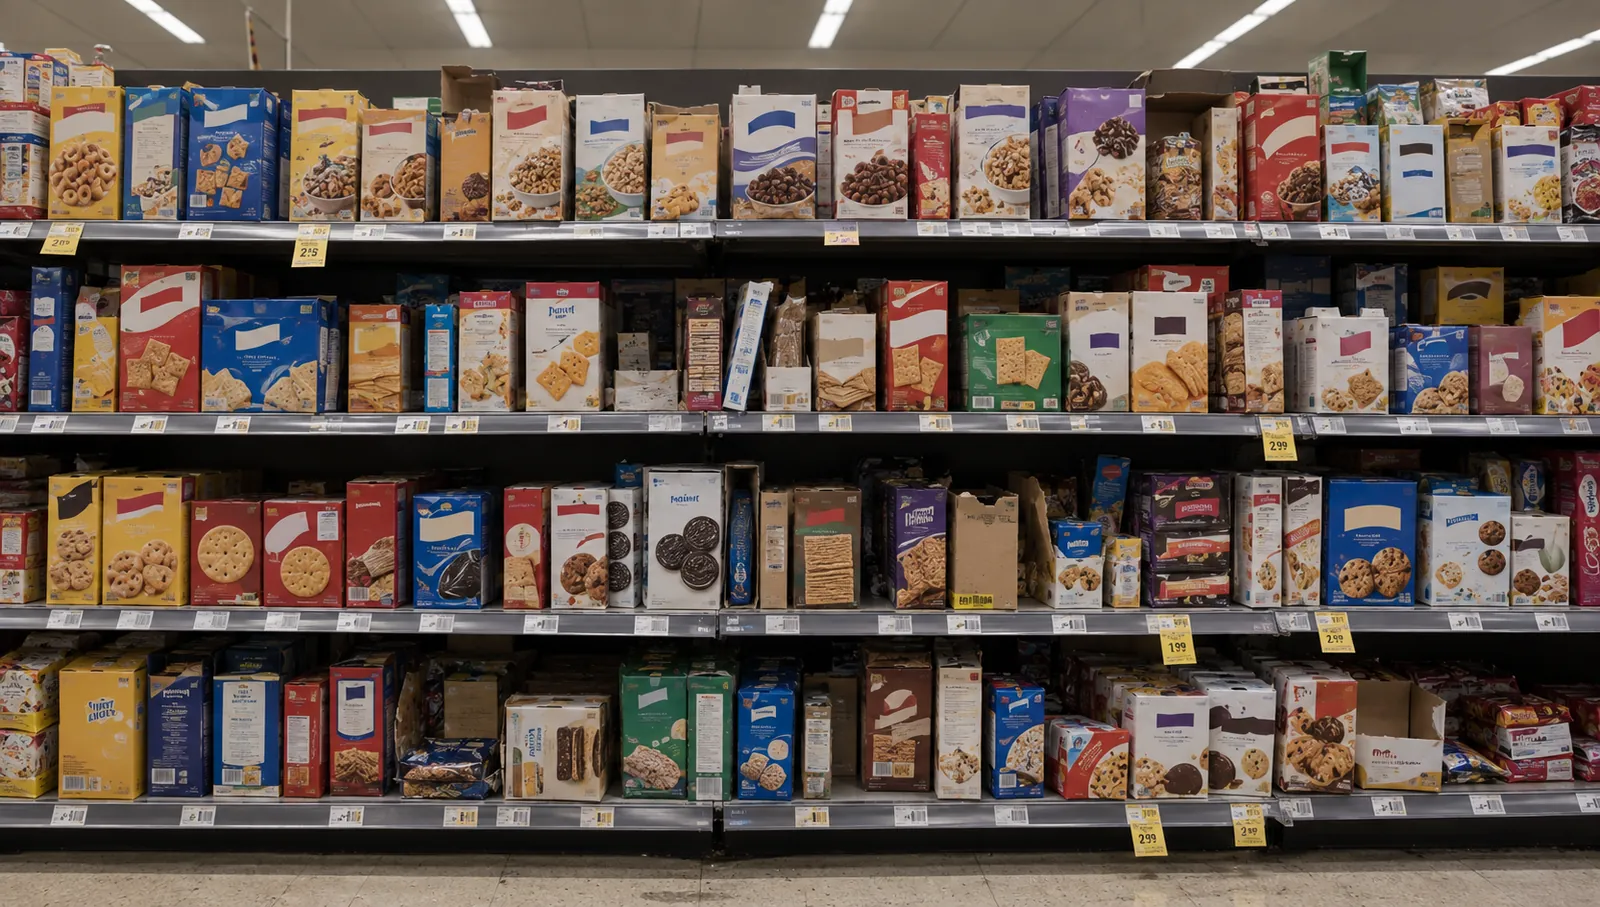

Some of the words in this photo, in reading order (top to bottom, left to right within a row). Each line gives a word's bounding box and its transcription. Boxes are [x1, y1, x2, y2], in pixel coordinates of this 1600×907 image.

[1269, 440, 1288, 451] 299
[1168, 642, 1187, 652] 199
[1138, 833, 1156, 844] 299
